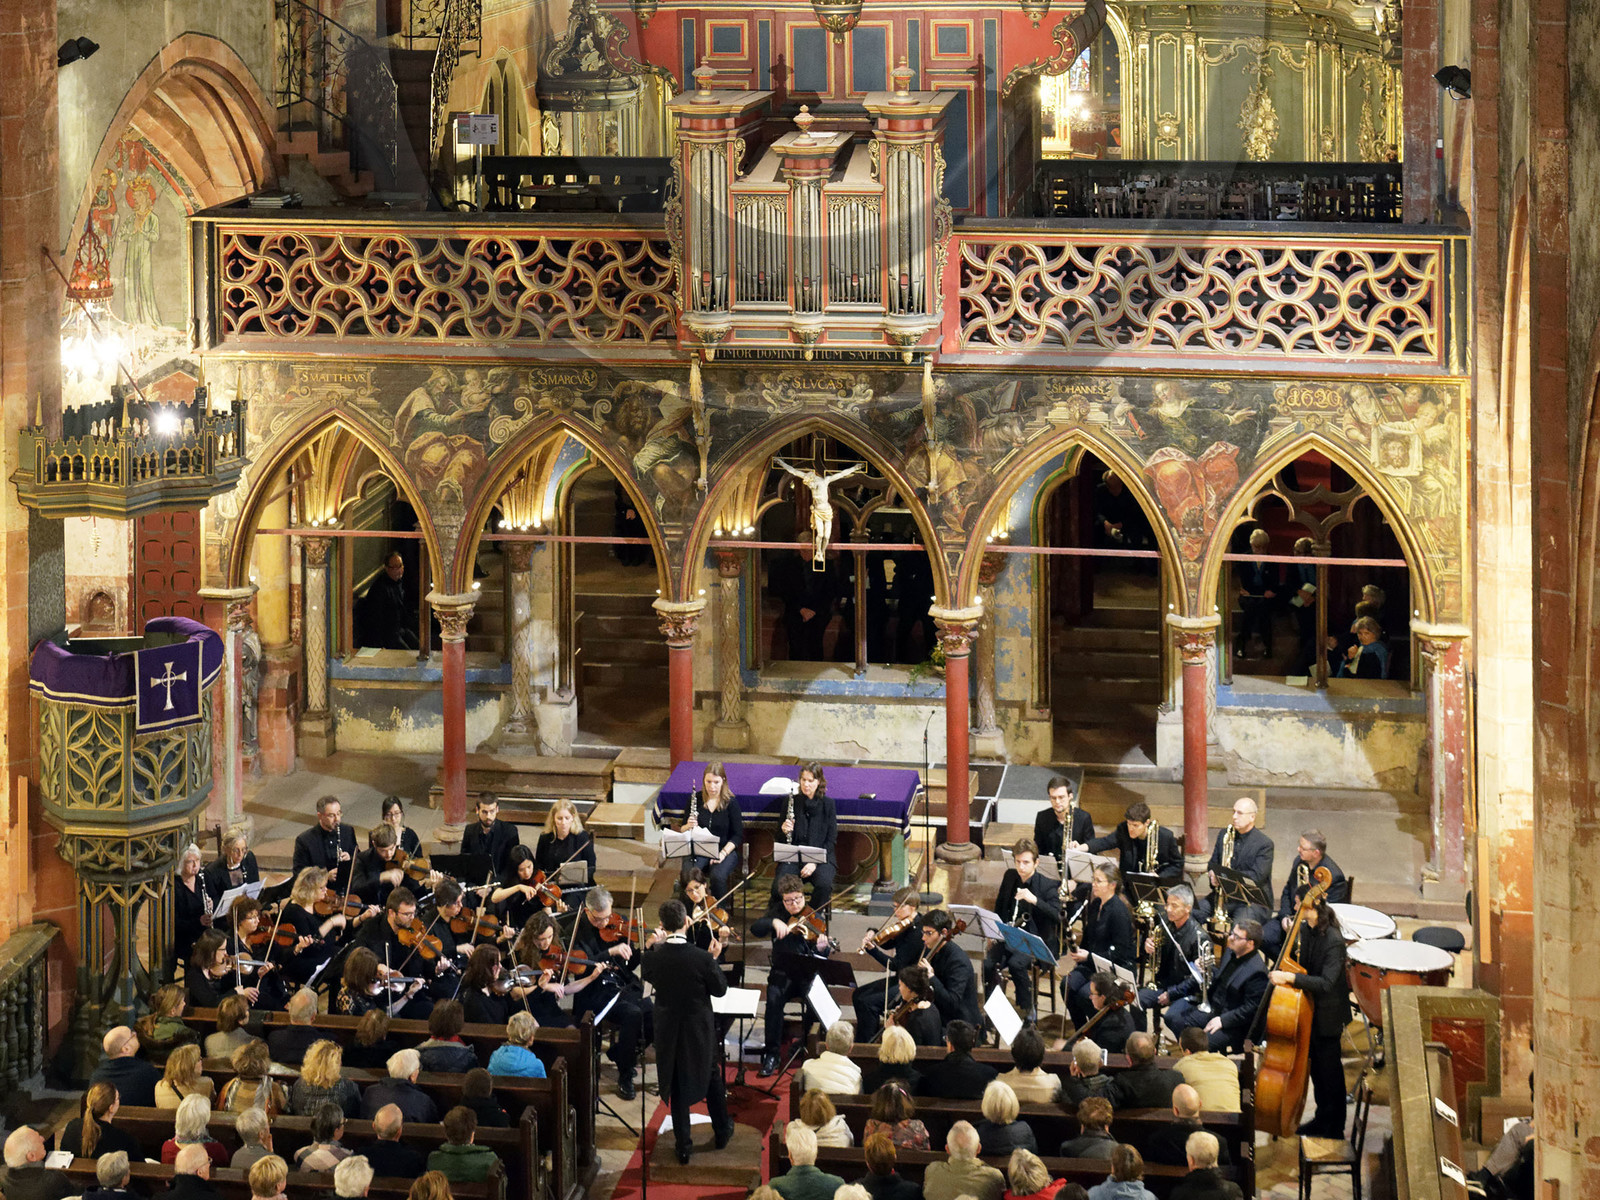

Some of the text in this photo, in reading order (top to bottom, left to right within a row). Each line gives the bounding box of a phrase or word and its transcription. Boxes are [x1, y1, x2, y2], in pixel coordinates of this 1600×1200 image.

[714, 348, 751, 359] TIMOR
[755, 348, 796, 360] DOMINI
[1286, 387, 1343, 408] 1620
